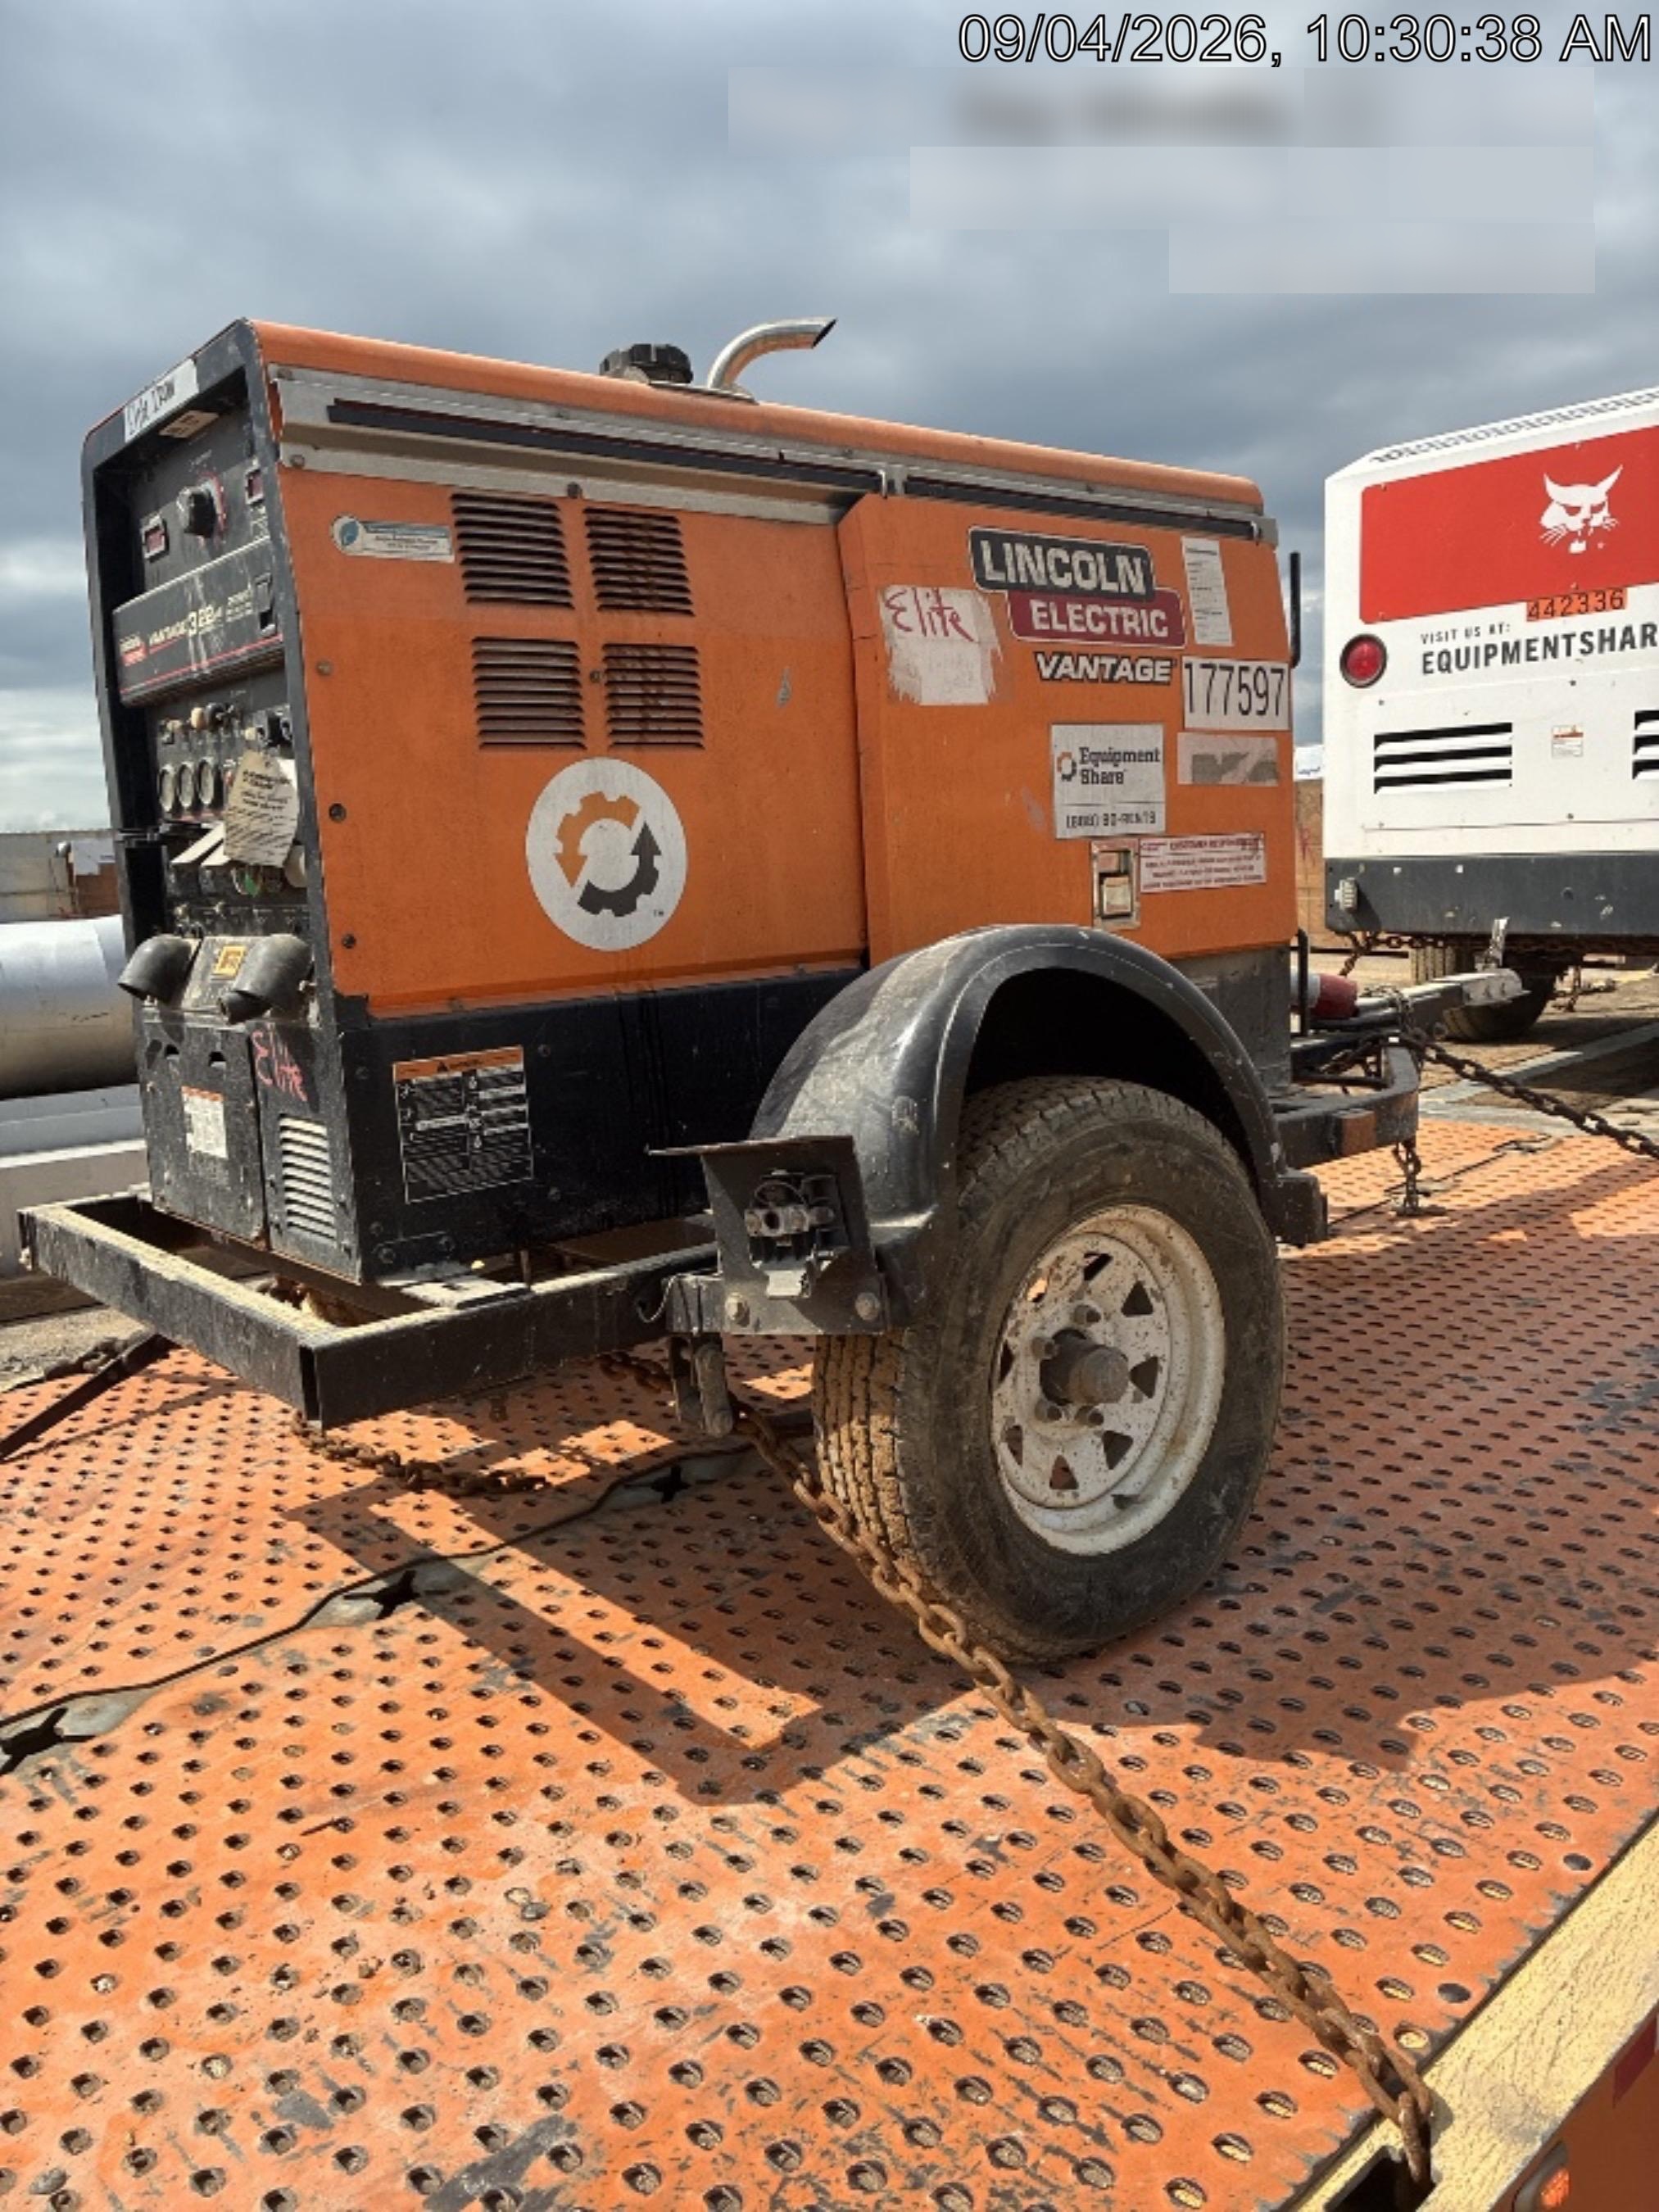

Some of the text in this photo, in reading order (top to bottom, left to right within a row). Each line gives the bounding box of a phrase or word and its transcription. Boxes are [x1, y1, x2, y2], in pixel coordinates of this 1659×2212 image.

[980, 539, 1146, 596] LINCOLN
[884, 586, 975, 643] Elite
[1029, 599, 1169, 638] ELECTRIC
[1527, 589, 1625, 620] 442336
[1420, 628, 1457, 645] VISIT
[1464, 626, 1481, 639] US
[1035, 652, 1172, 685] VANTAGE
[1184, 662, 1285, 716] 177597
[1078, 746, 1161, 768] Equipment
[1080, 768, 1125, 785] Share
